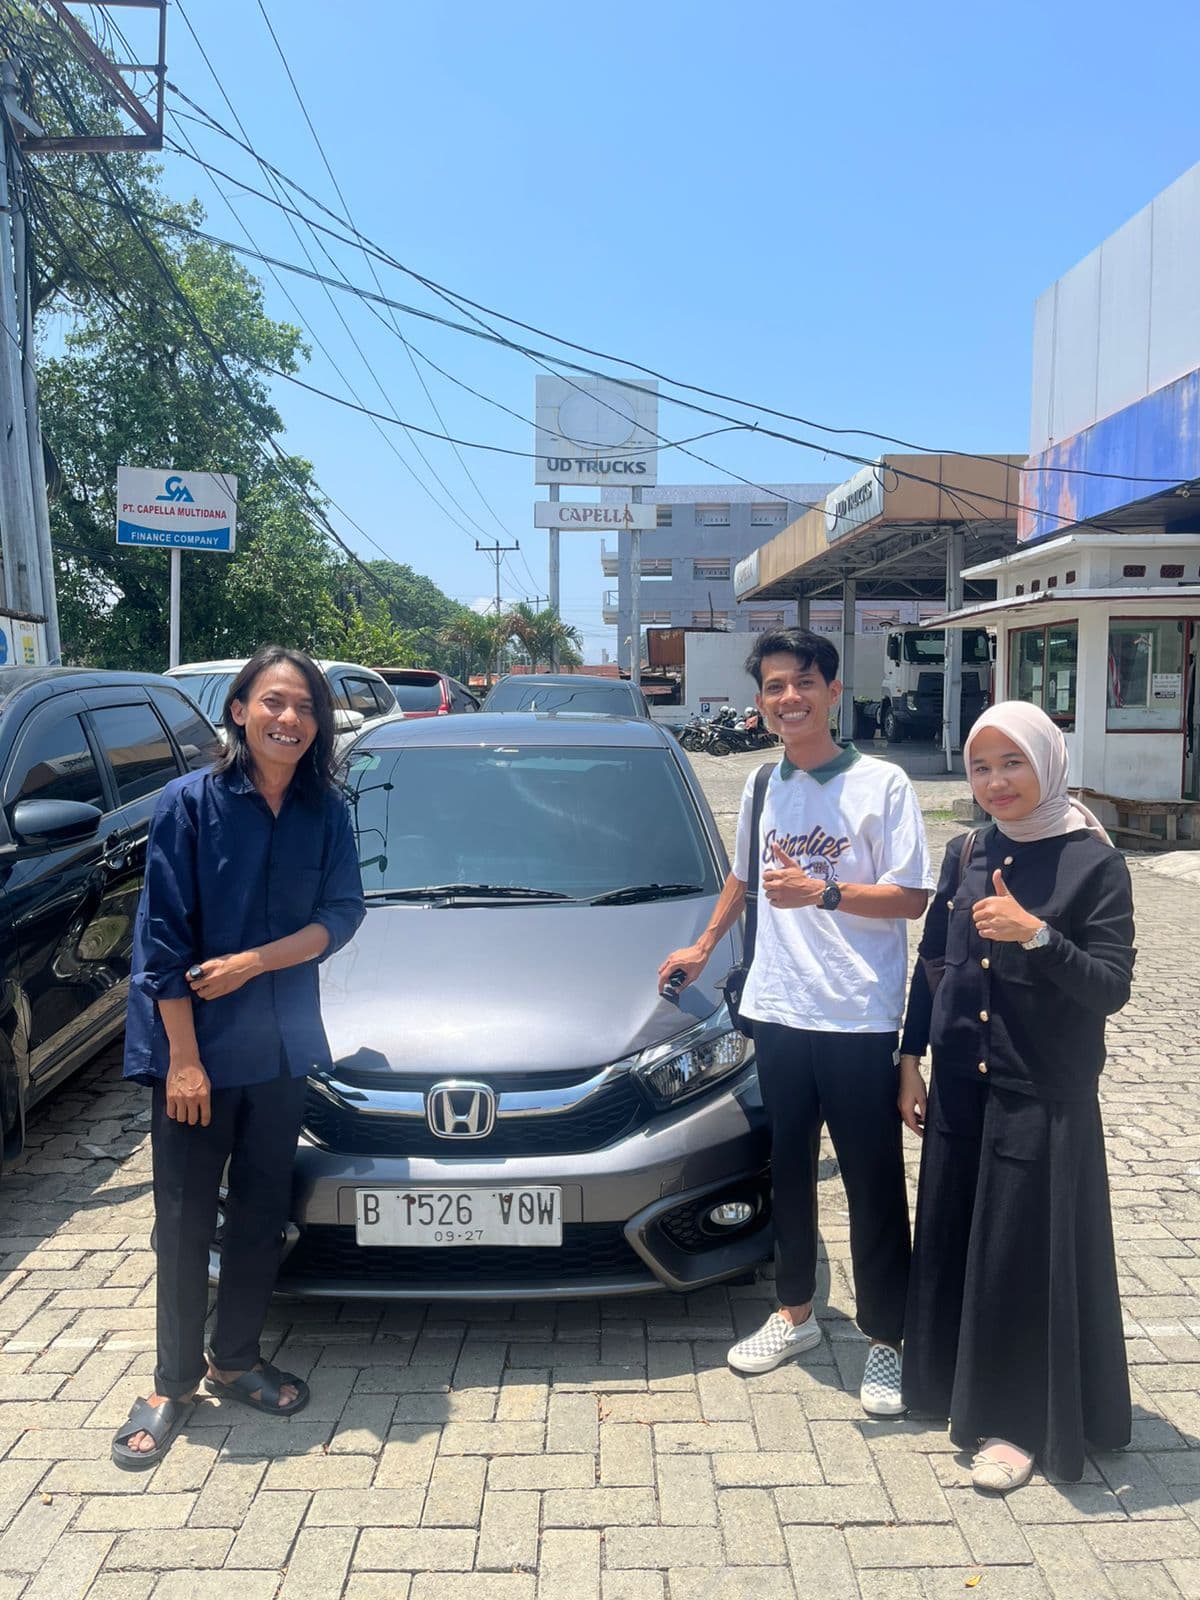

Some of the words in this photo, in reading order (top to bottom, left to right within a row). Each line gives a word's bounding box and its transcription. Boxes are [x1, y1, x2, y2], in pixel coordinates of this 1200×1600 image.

[547, 459, 572, 472] UD
[575, 461, 646, 474] TRUCKS
[122, 503, 135, 513] PT.
[137, 504, 175, 516] CAPELLA
[177, 507, 227, 519] MULTIDANA
[559, 507, 634, 523] CAPELLA
[131, 531, 172, 543] FINANCE
[173, 534, 219, 545] COMPANY
[363, 1193, 380, 1225] B
[402, 1193, 473, 1226] 1526
